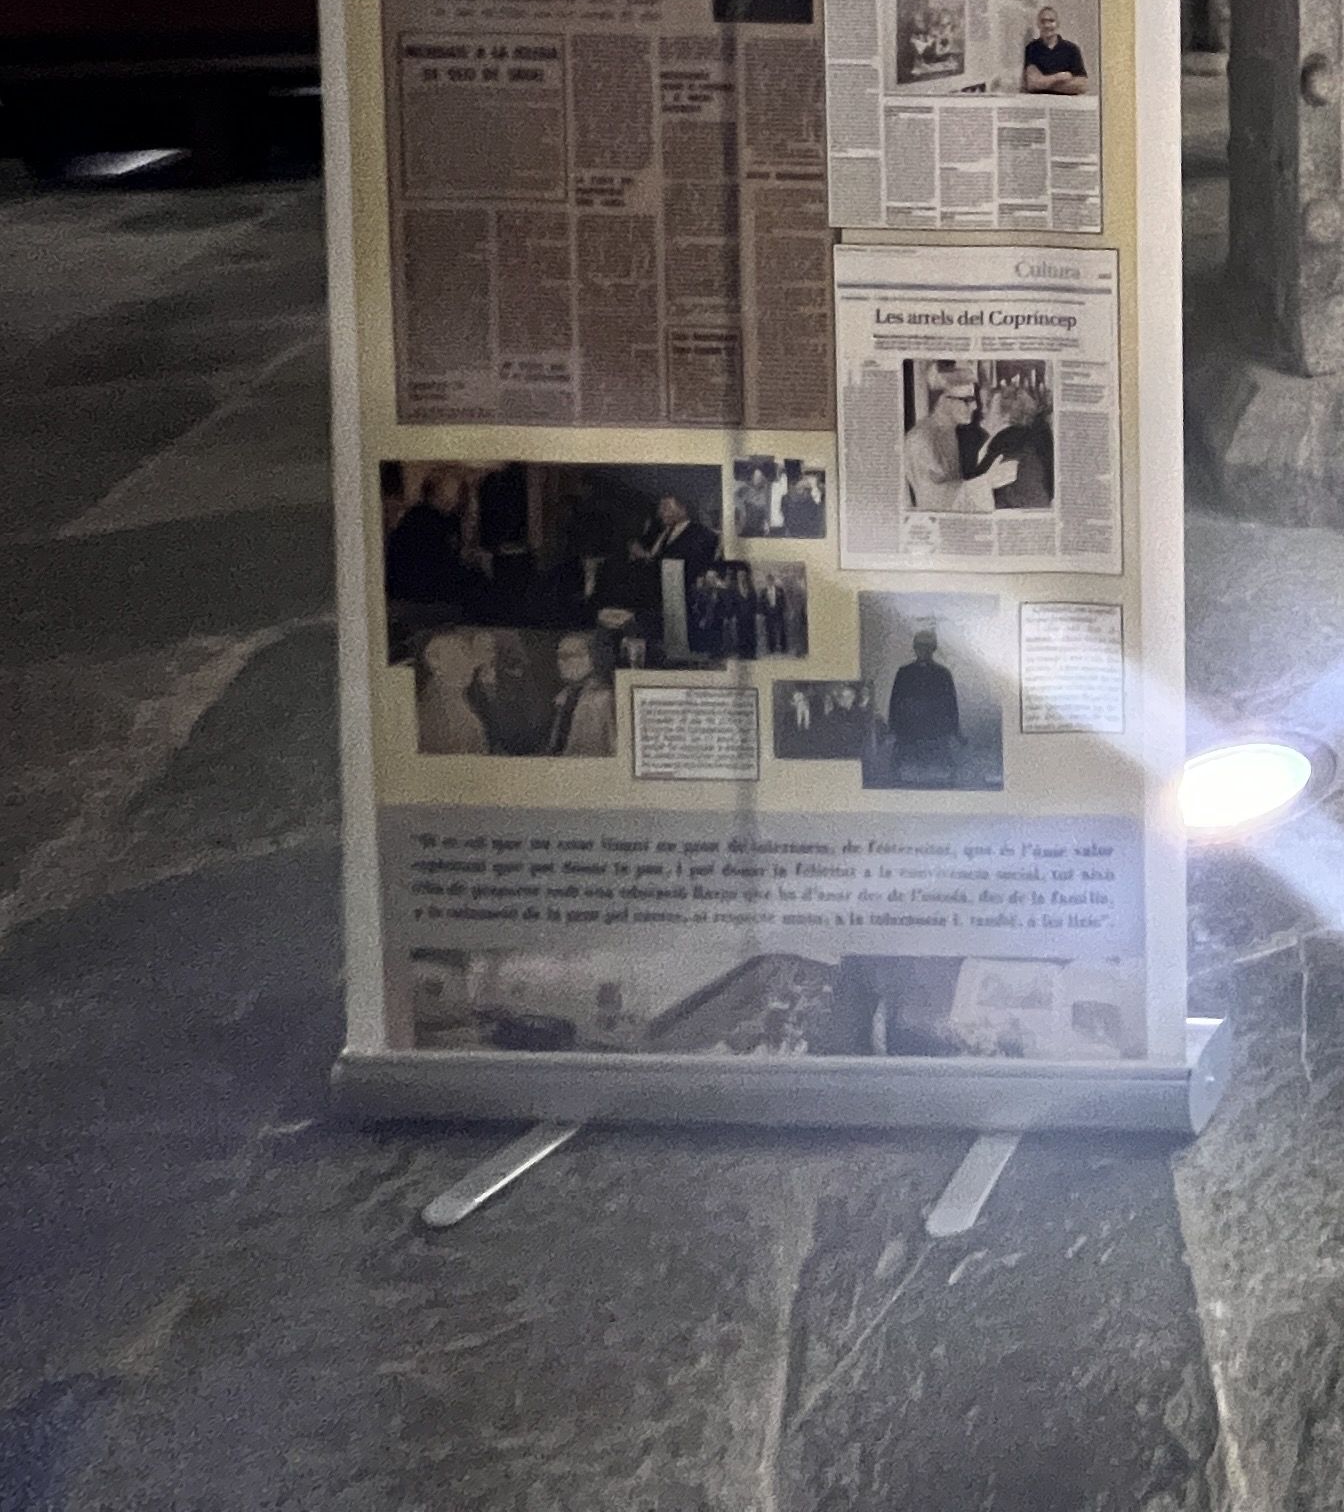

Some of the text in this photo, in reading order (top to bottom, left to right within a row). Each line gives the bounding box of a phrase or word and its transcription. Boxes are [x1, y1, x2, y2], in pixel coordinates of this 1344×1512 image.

[875, 308, 904, 326] Les
[907, 310, 954, 327] arrels
[957, 310, 985, 327] del
